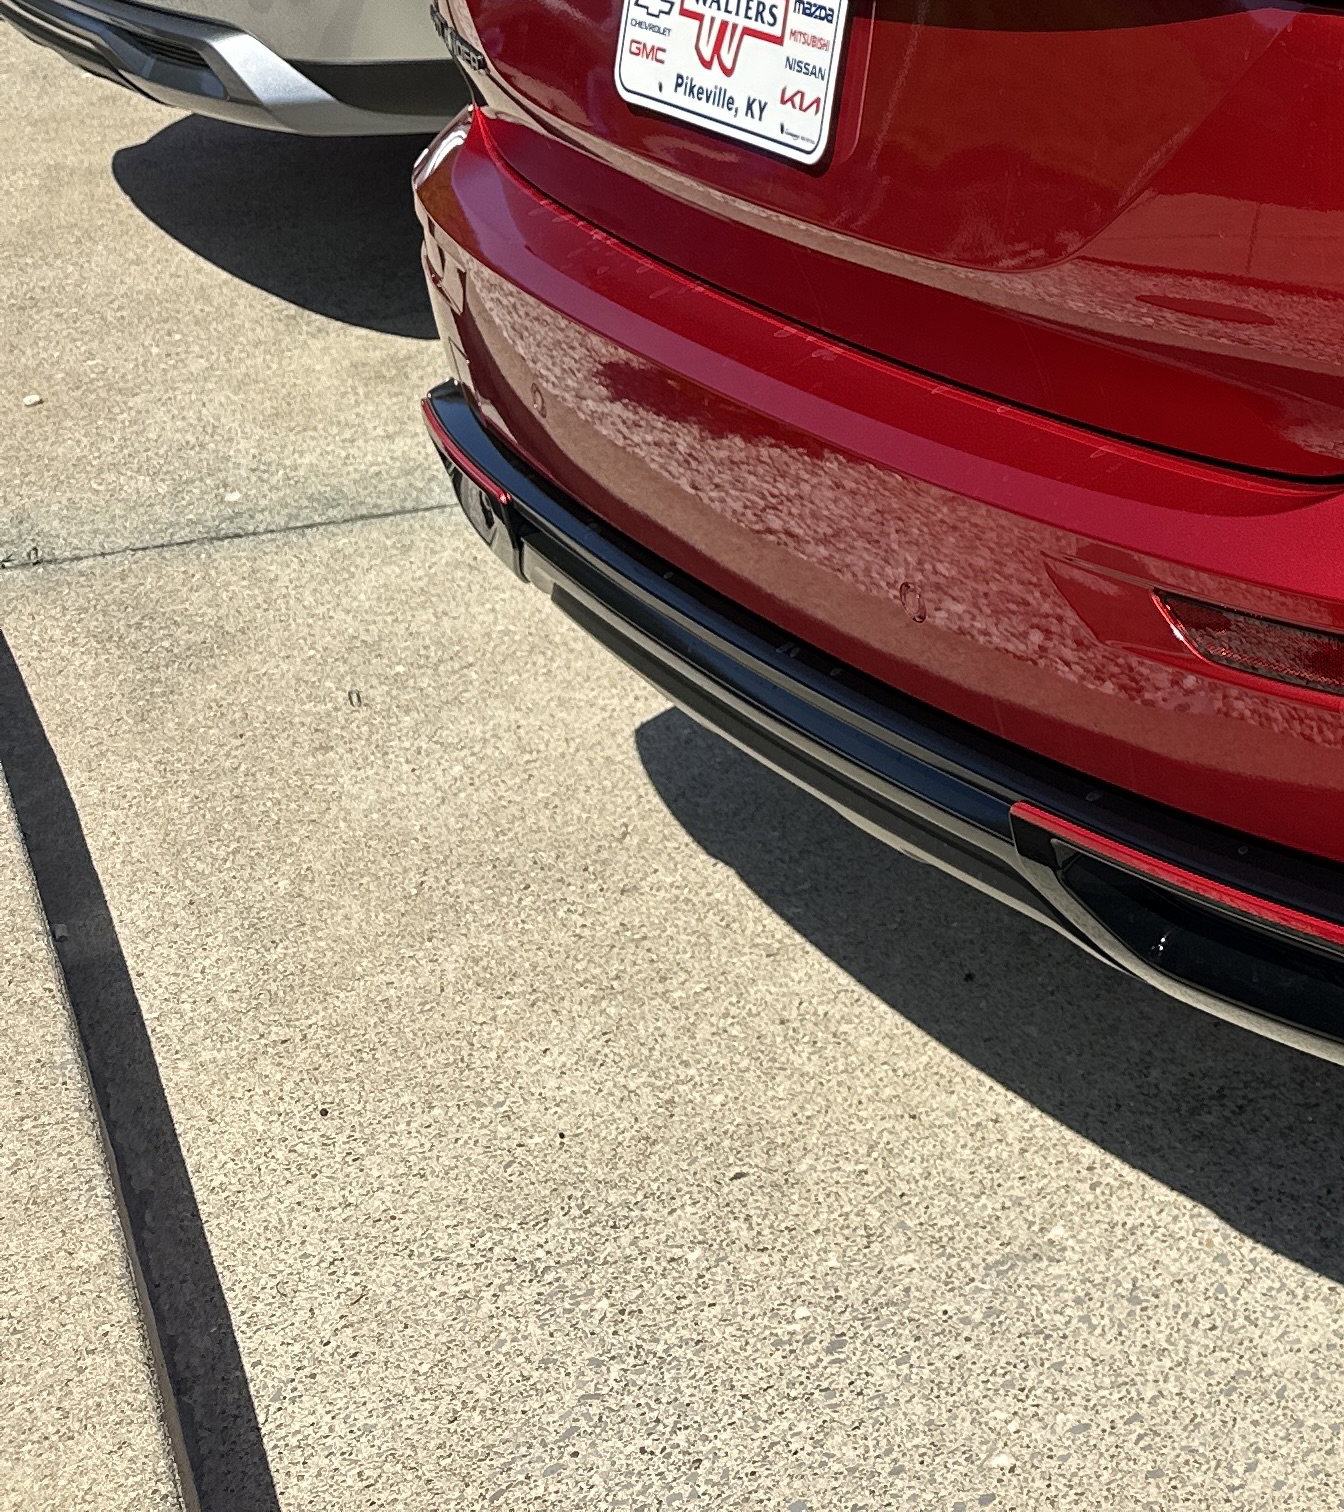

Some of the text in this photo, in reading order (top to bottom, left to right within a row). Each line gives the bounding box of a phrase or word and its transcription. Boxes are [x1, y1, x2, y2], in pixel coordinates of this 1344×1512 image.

[630, 18, 672, 37] CHEVROLET
[629, 40, 666, 64] GMC
[789, 29, 830, 52] MITSUBISHI
[784, 55, 827, 81] NISSAN
[673, 73, 768, 122] Pikeville, KY
